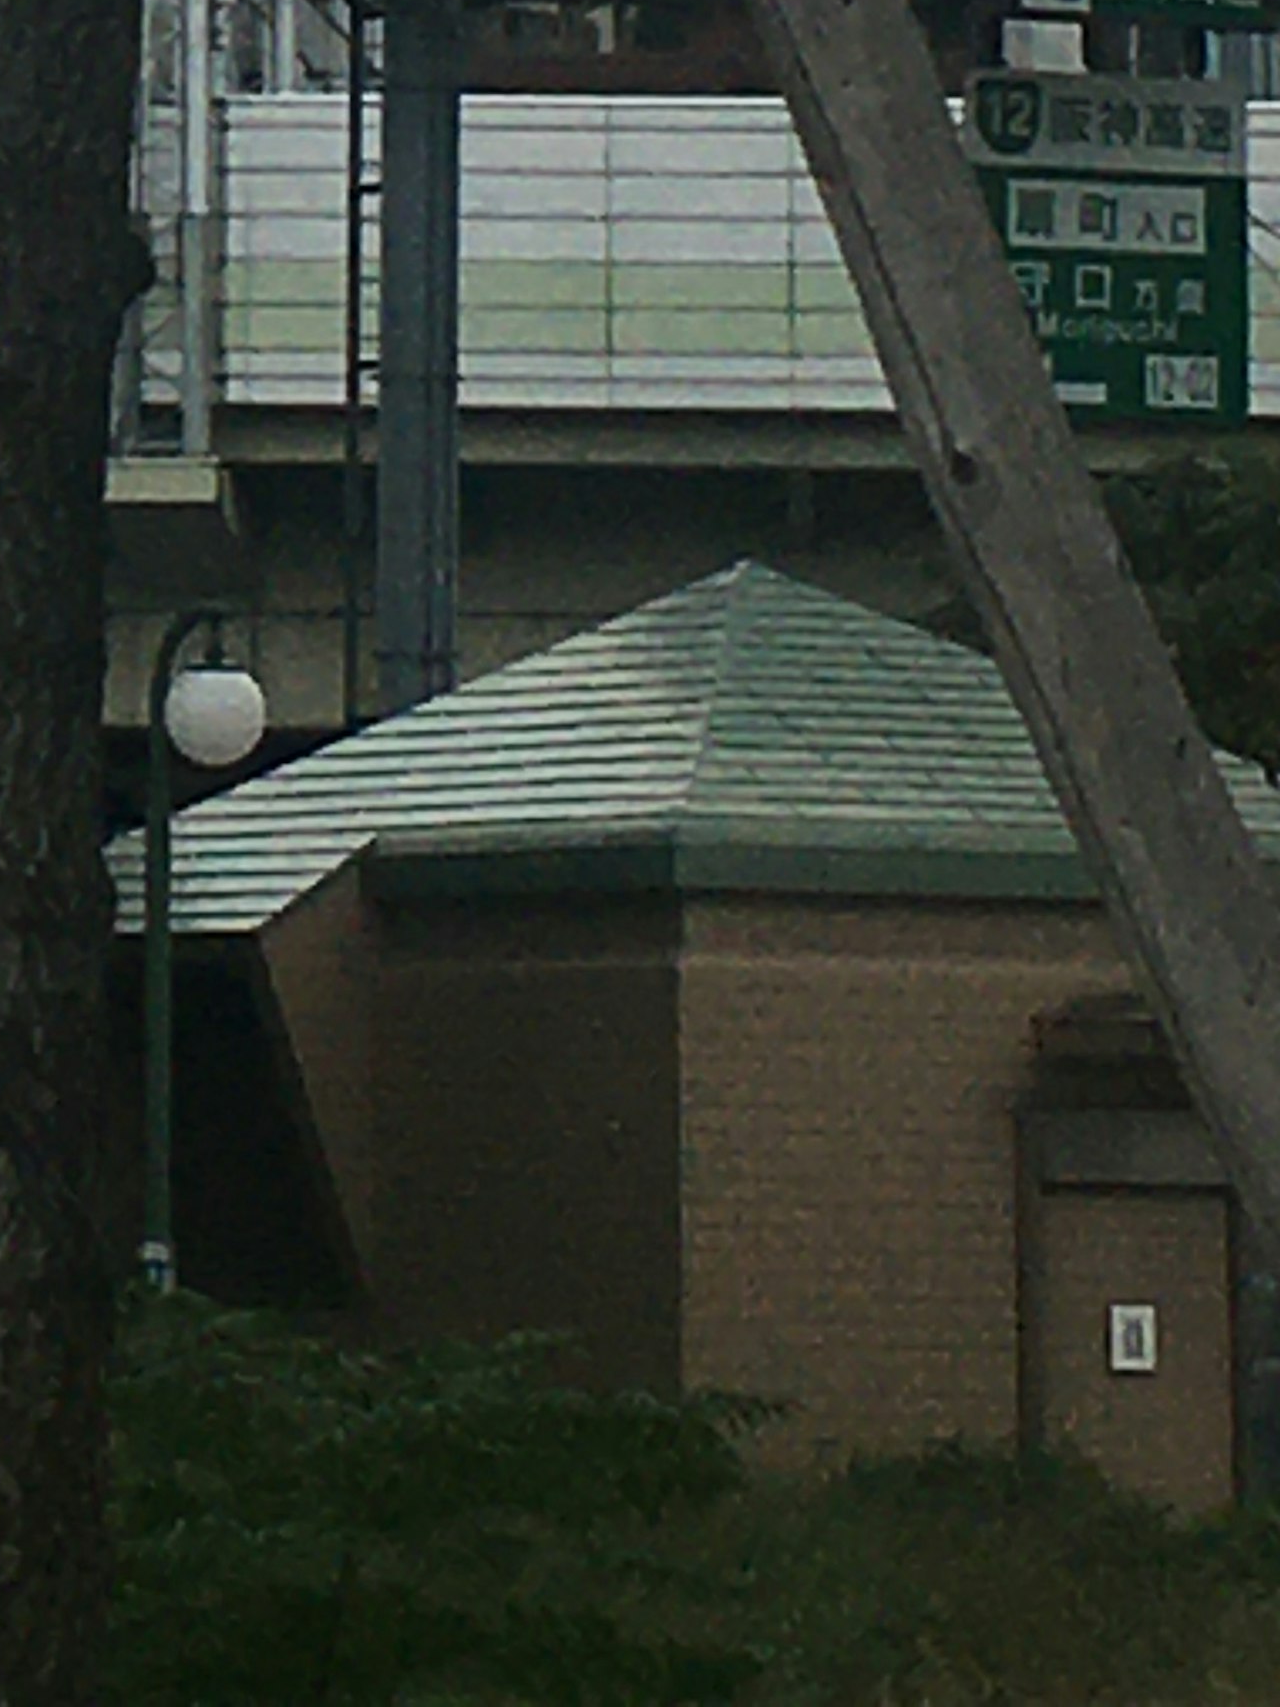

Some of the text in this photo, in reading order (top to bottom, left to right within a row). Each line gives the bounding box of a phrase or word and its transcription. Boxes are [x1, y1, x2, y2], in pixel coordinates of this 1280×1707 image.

[992, 90, 1232, 152] 12 阪神高速
